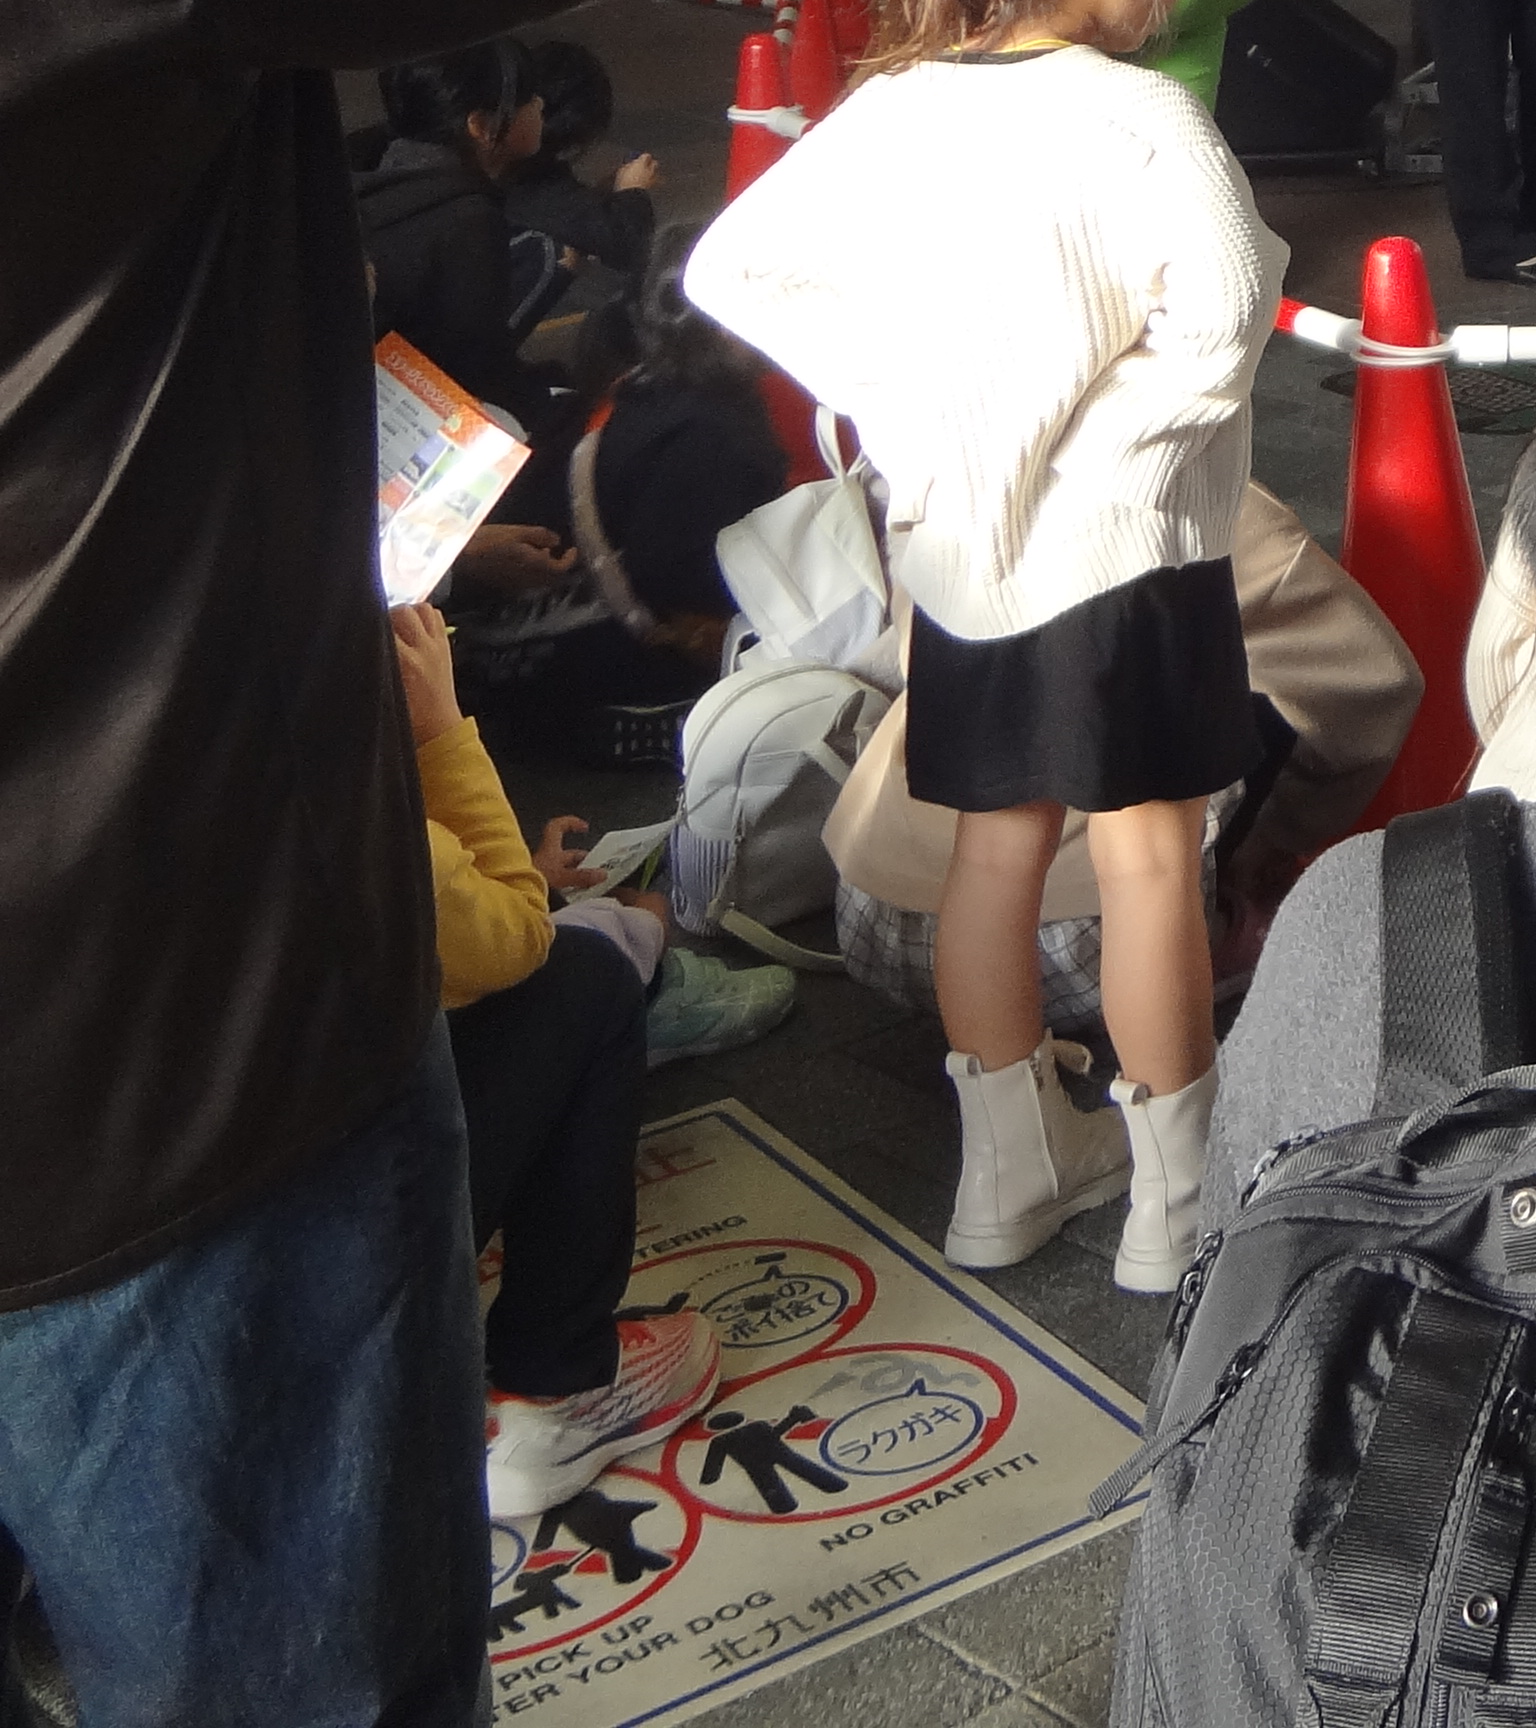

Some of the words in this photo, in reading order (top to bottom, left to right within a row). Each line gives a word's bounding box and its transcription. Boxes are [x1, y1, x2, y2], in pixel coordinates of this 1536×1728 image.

[634, 1215, 748, 1259] TERING
[726, 1291, 835, 1342] ポイ捨て
[836, 1404, 963, 1464] ラクガキ
[819, 1522, 875, 1553] NO
[879, 1452, 1039, 1525] GRAFFITI
[496, 1642, 592, 1693] PICK
[601, 1614, 655, 1646] UP
[568, 1631, 681, 1685] YOUR
[684, 1589, 776, 1636] DOG
[699, 1560, 921, 1673] 北九州市
